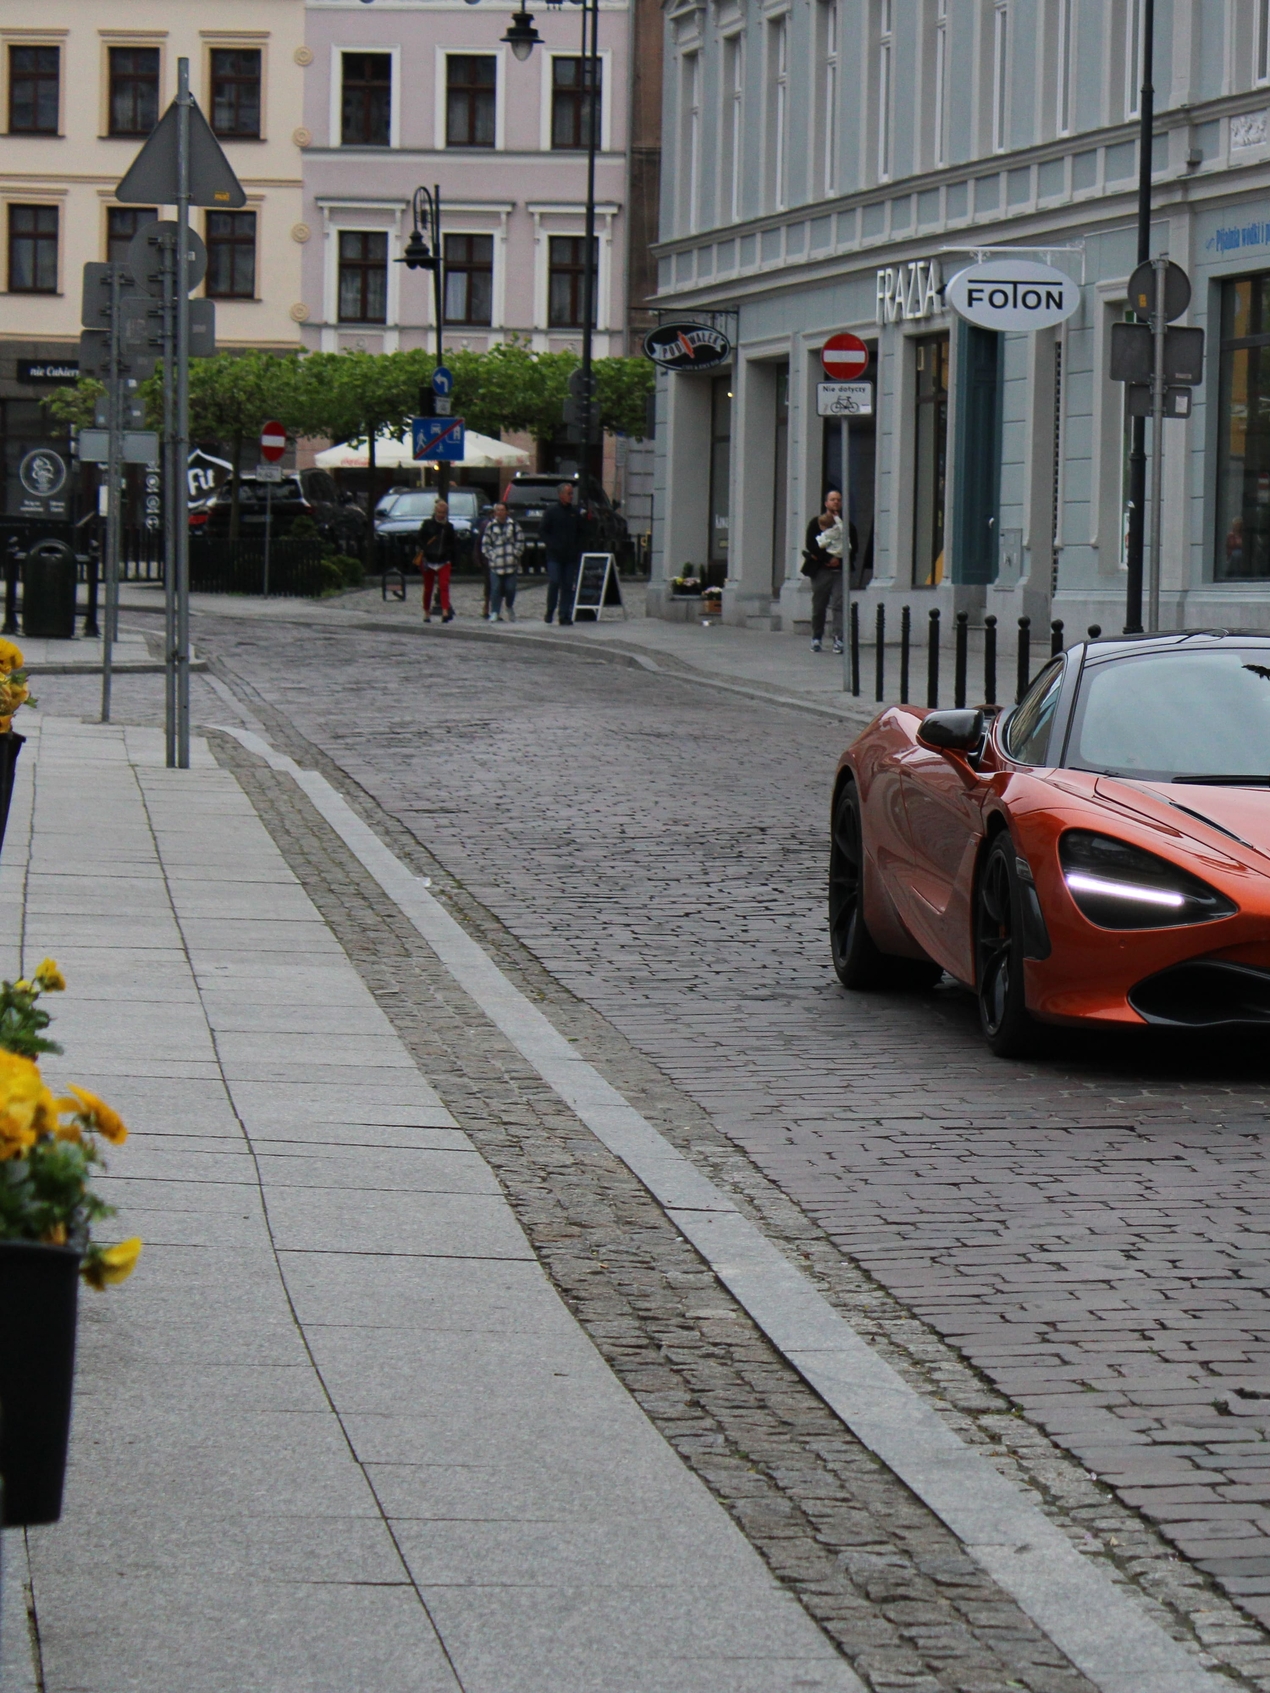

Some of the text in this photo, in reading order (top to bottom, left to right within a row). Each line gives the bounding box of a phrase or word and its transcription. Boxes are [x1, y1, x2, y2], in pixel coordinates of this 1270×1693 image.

[967, 279, 1064, 311] FOTON
[662, 342, 683, 358] POD
[838, 385, 866, 394] dotyczy
